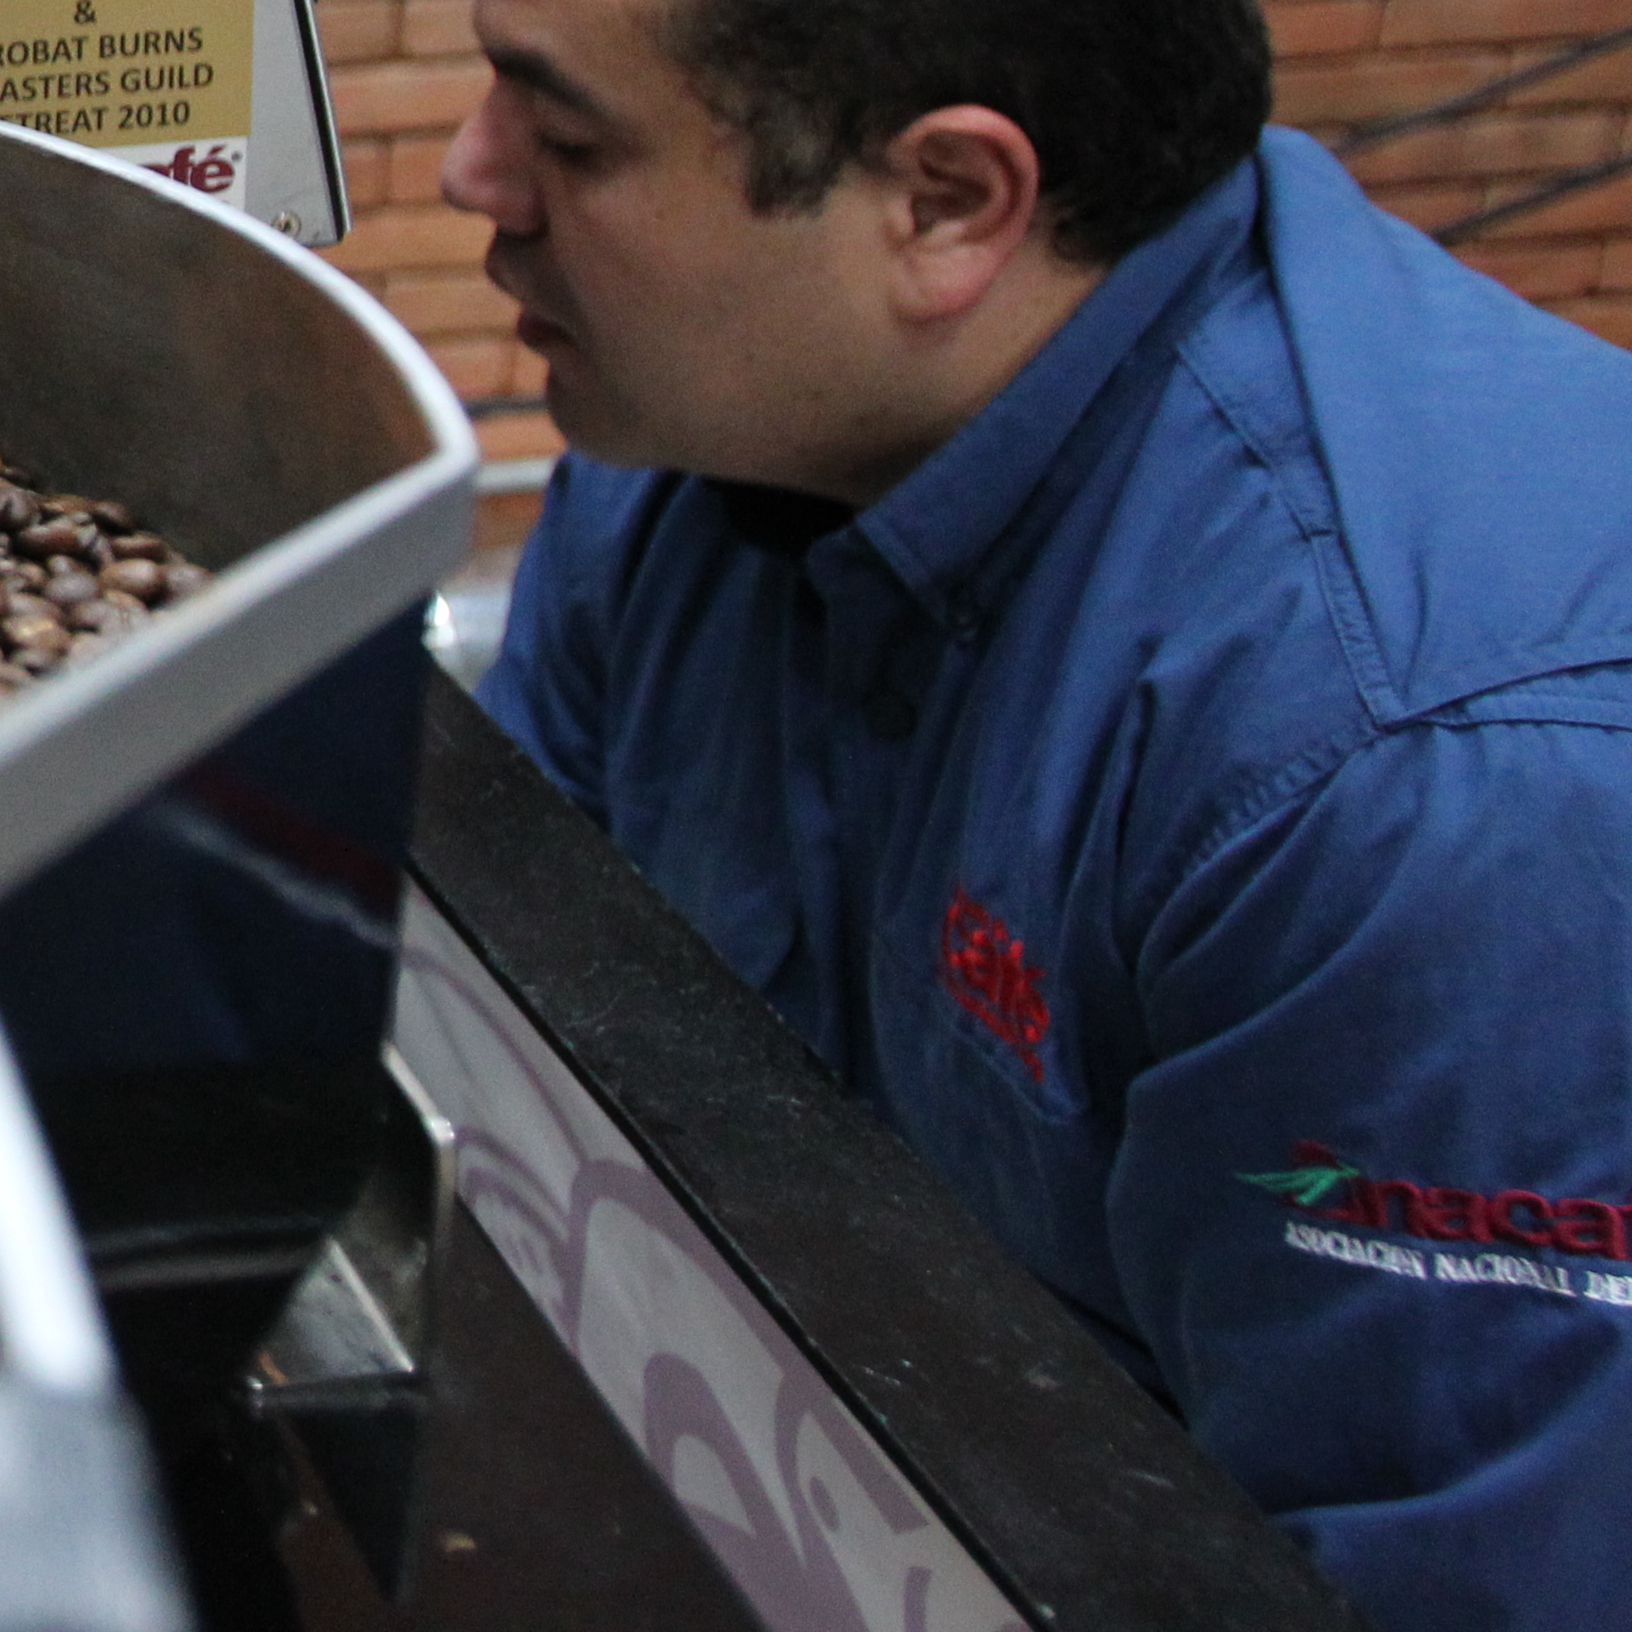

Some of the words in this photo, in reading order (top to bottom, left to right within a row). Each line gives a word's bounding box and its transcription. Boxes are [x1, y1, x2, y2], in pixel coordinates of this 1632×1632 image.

[98, 27, 204, 58] BURNS
[120, 62, 214, 92] GUILD
[0, 105, 109, 134] TREAT
[118, 100, 191, 130] 2010
[1282, 1140, 1632, 1260] anaca
